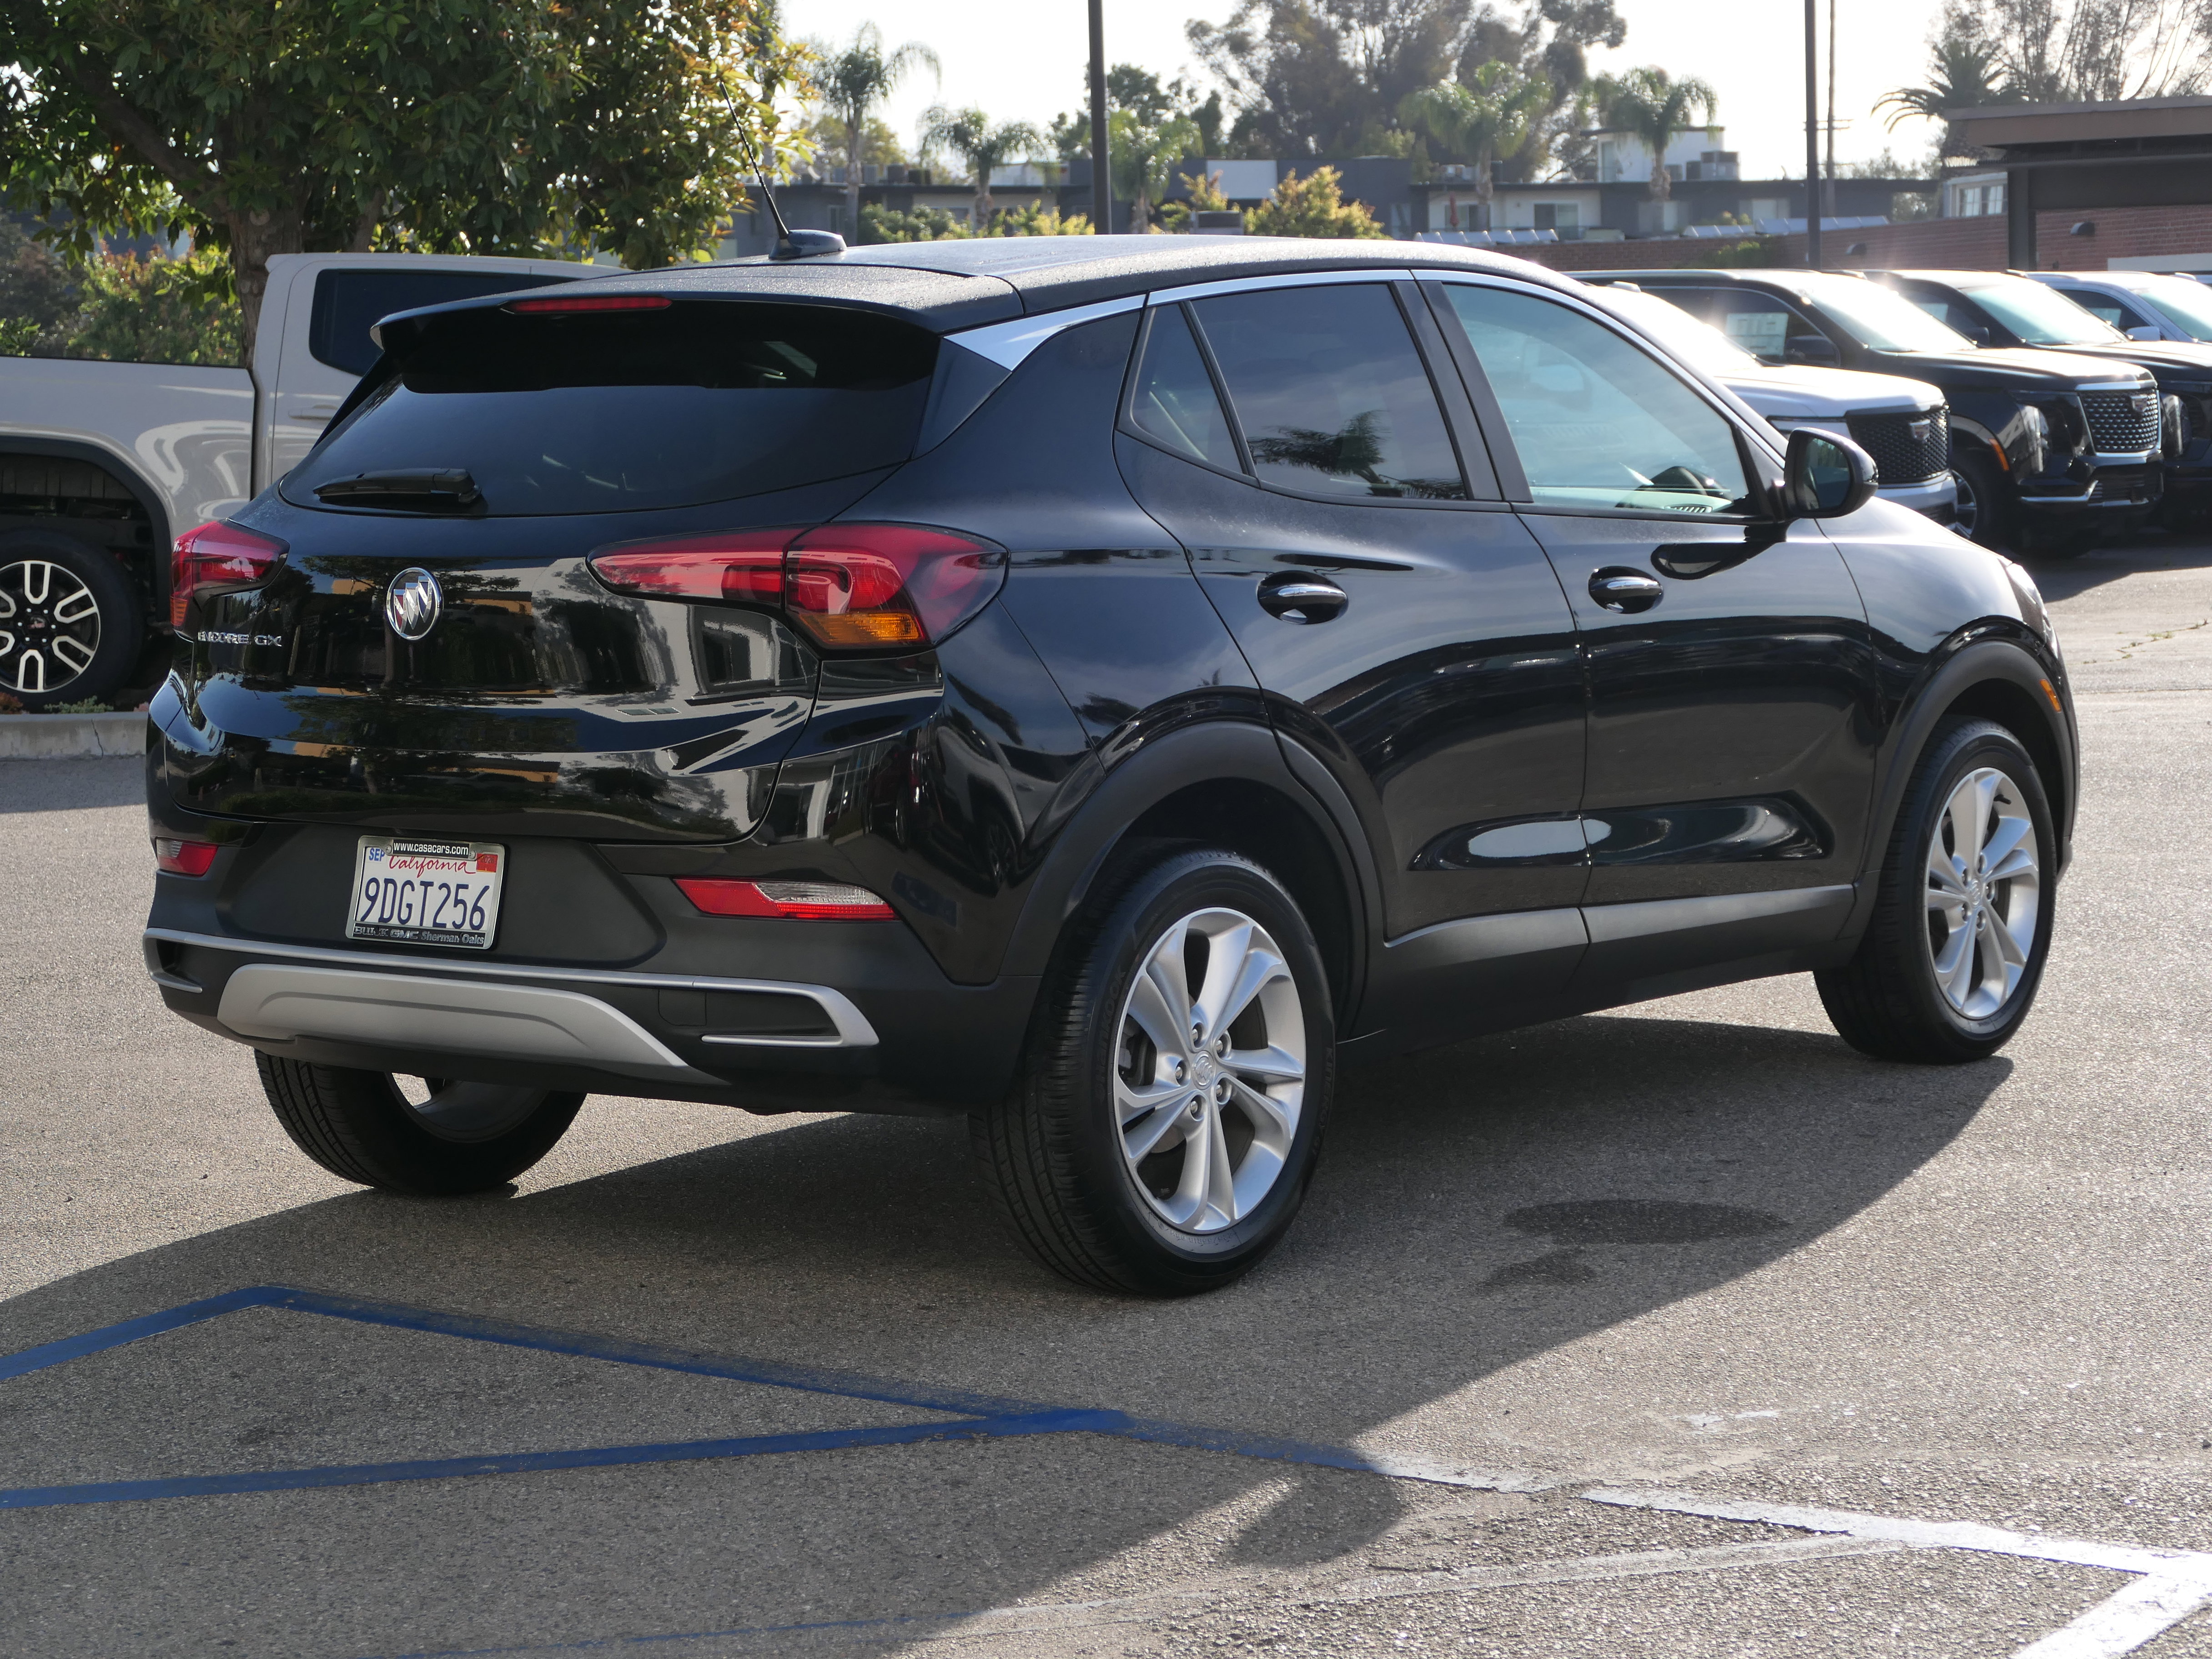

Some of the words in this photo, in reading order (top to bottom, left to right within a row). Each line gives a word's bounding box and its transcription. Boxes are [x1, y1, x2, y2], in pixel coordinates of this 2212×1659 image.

[198, 631, 249, 644] ENCORE
[254, 634, 282, 647] GX
[369, 848, 385, 861] SEP
[394, 842, 468, 855] www.casacars.com
[389, 855, 475, 878] California
[361, 877, 490, 930] 9DGT256
[354, 926, 389, 937] BUICK
[390, 929, 419, 939] GMC
[421, 930, 459, 943] Sherman
[462, 934, 484, 944] Oaks
